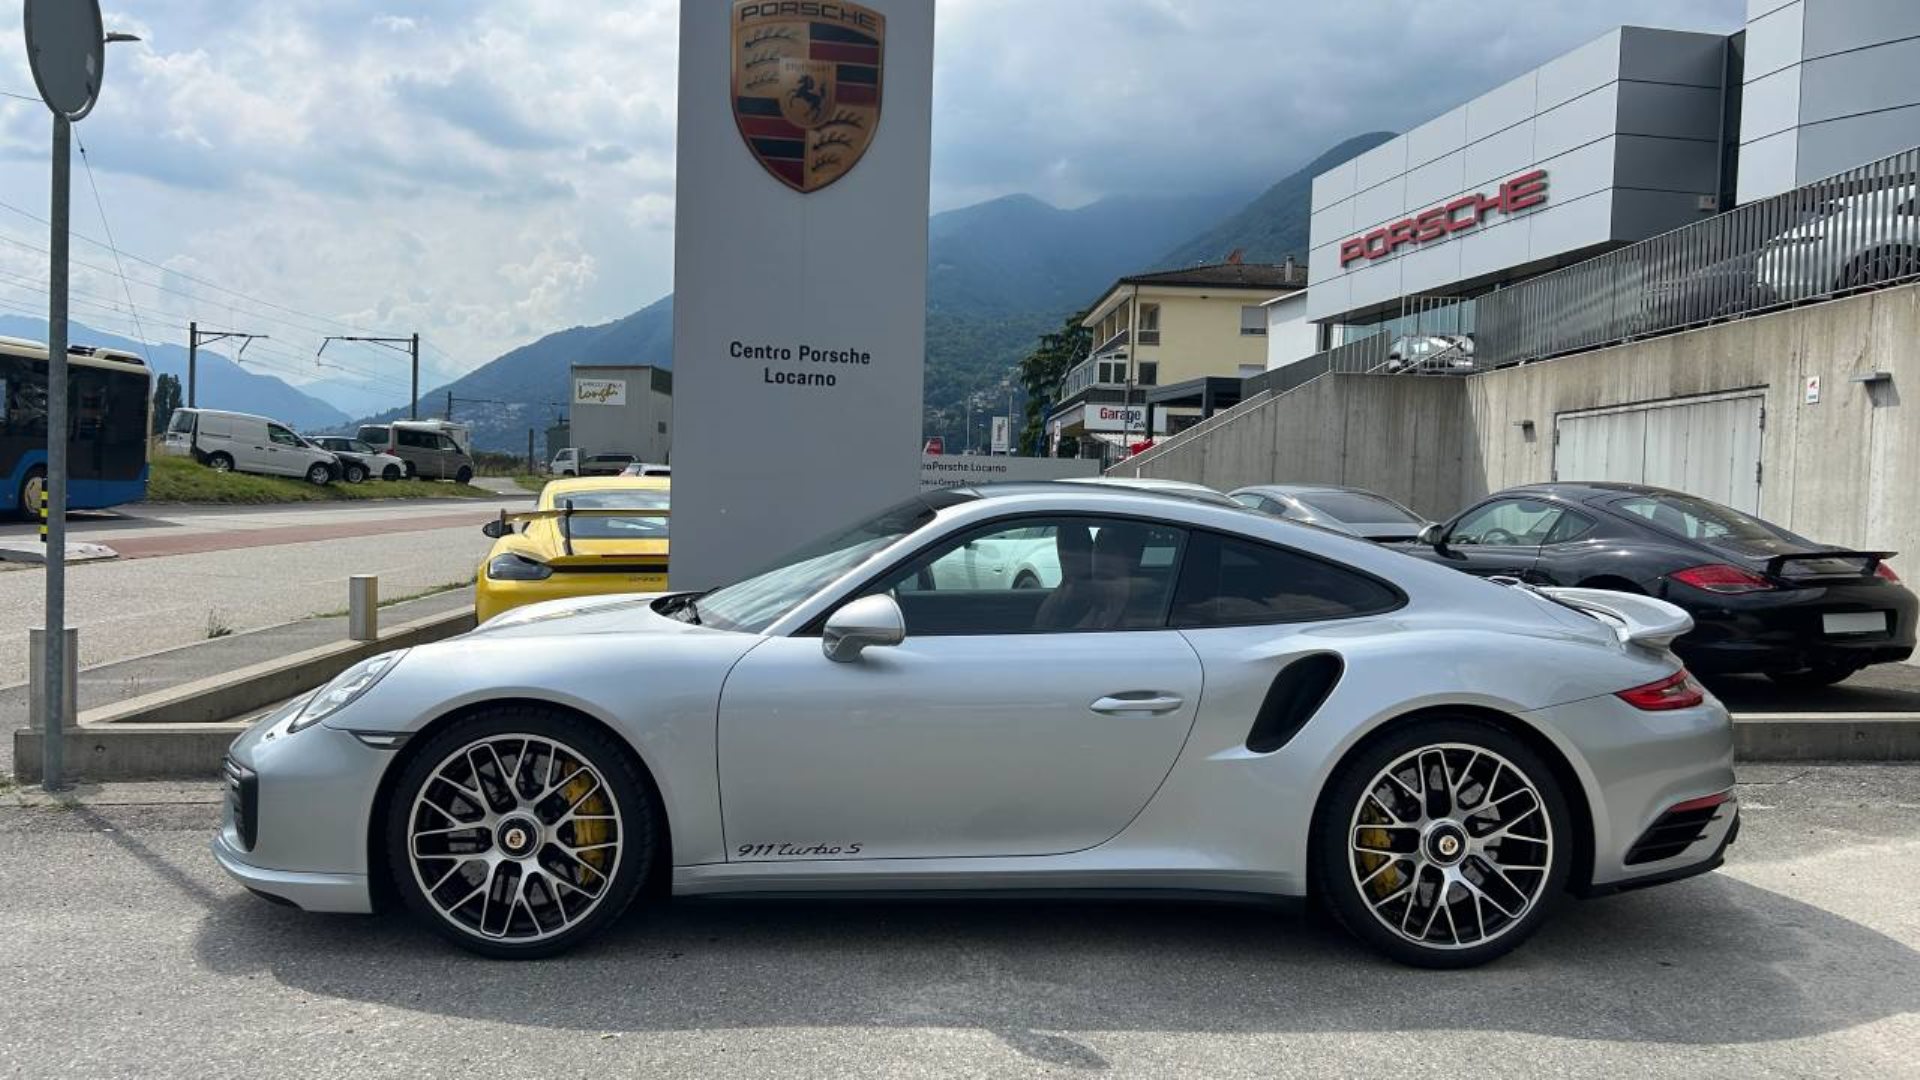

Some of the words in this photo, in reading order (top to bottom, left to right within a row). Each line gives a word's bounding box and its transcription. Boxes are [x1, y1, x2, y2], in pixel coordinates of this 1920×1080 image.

[740, 2, 877, 32] PORSCHE
[1340, 169, 1548, 268] PORSCHE
[729, 341, 791, 360] Centro
[798, 345, 871, 364] Porsche
[764, 367, 836, 386] Locarno
[1100, 407, 1141, 423] Garage
[971, 463, 1007, 473] Locarno
[738, 843, 774, 856] 911
[844, 842, 863, 854] S
